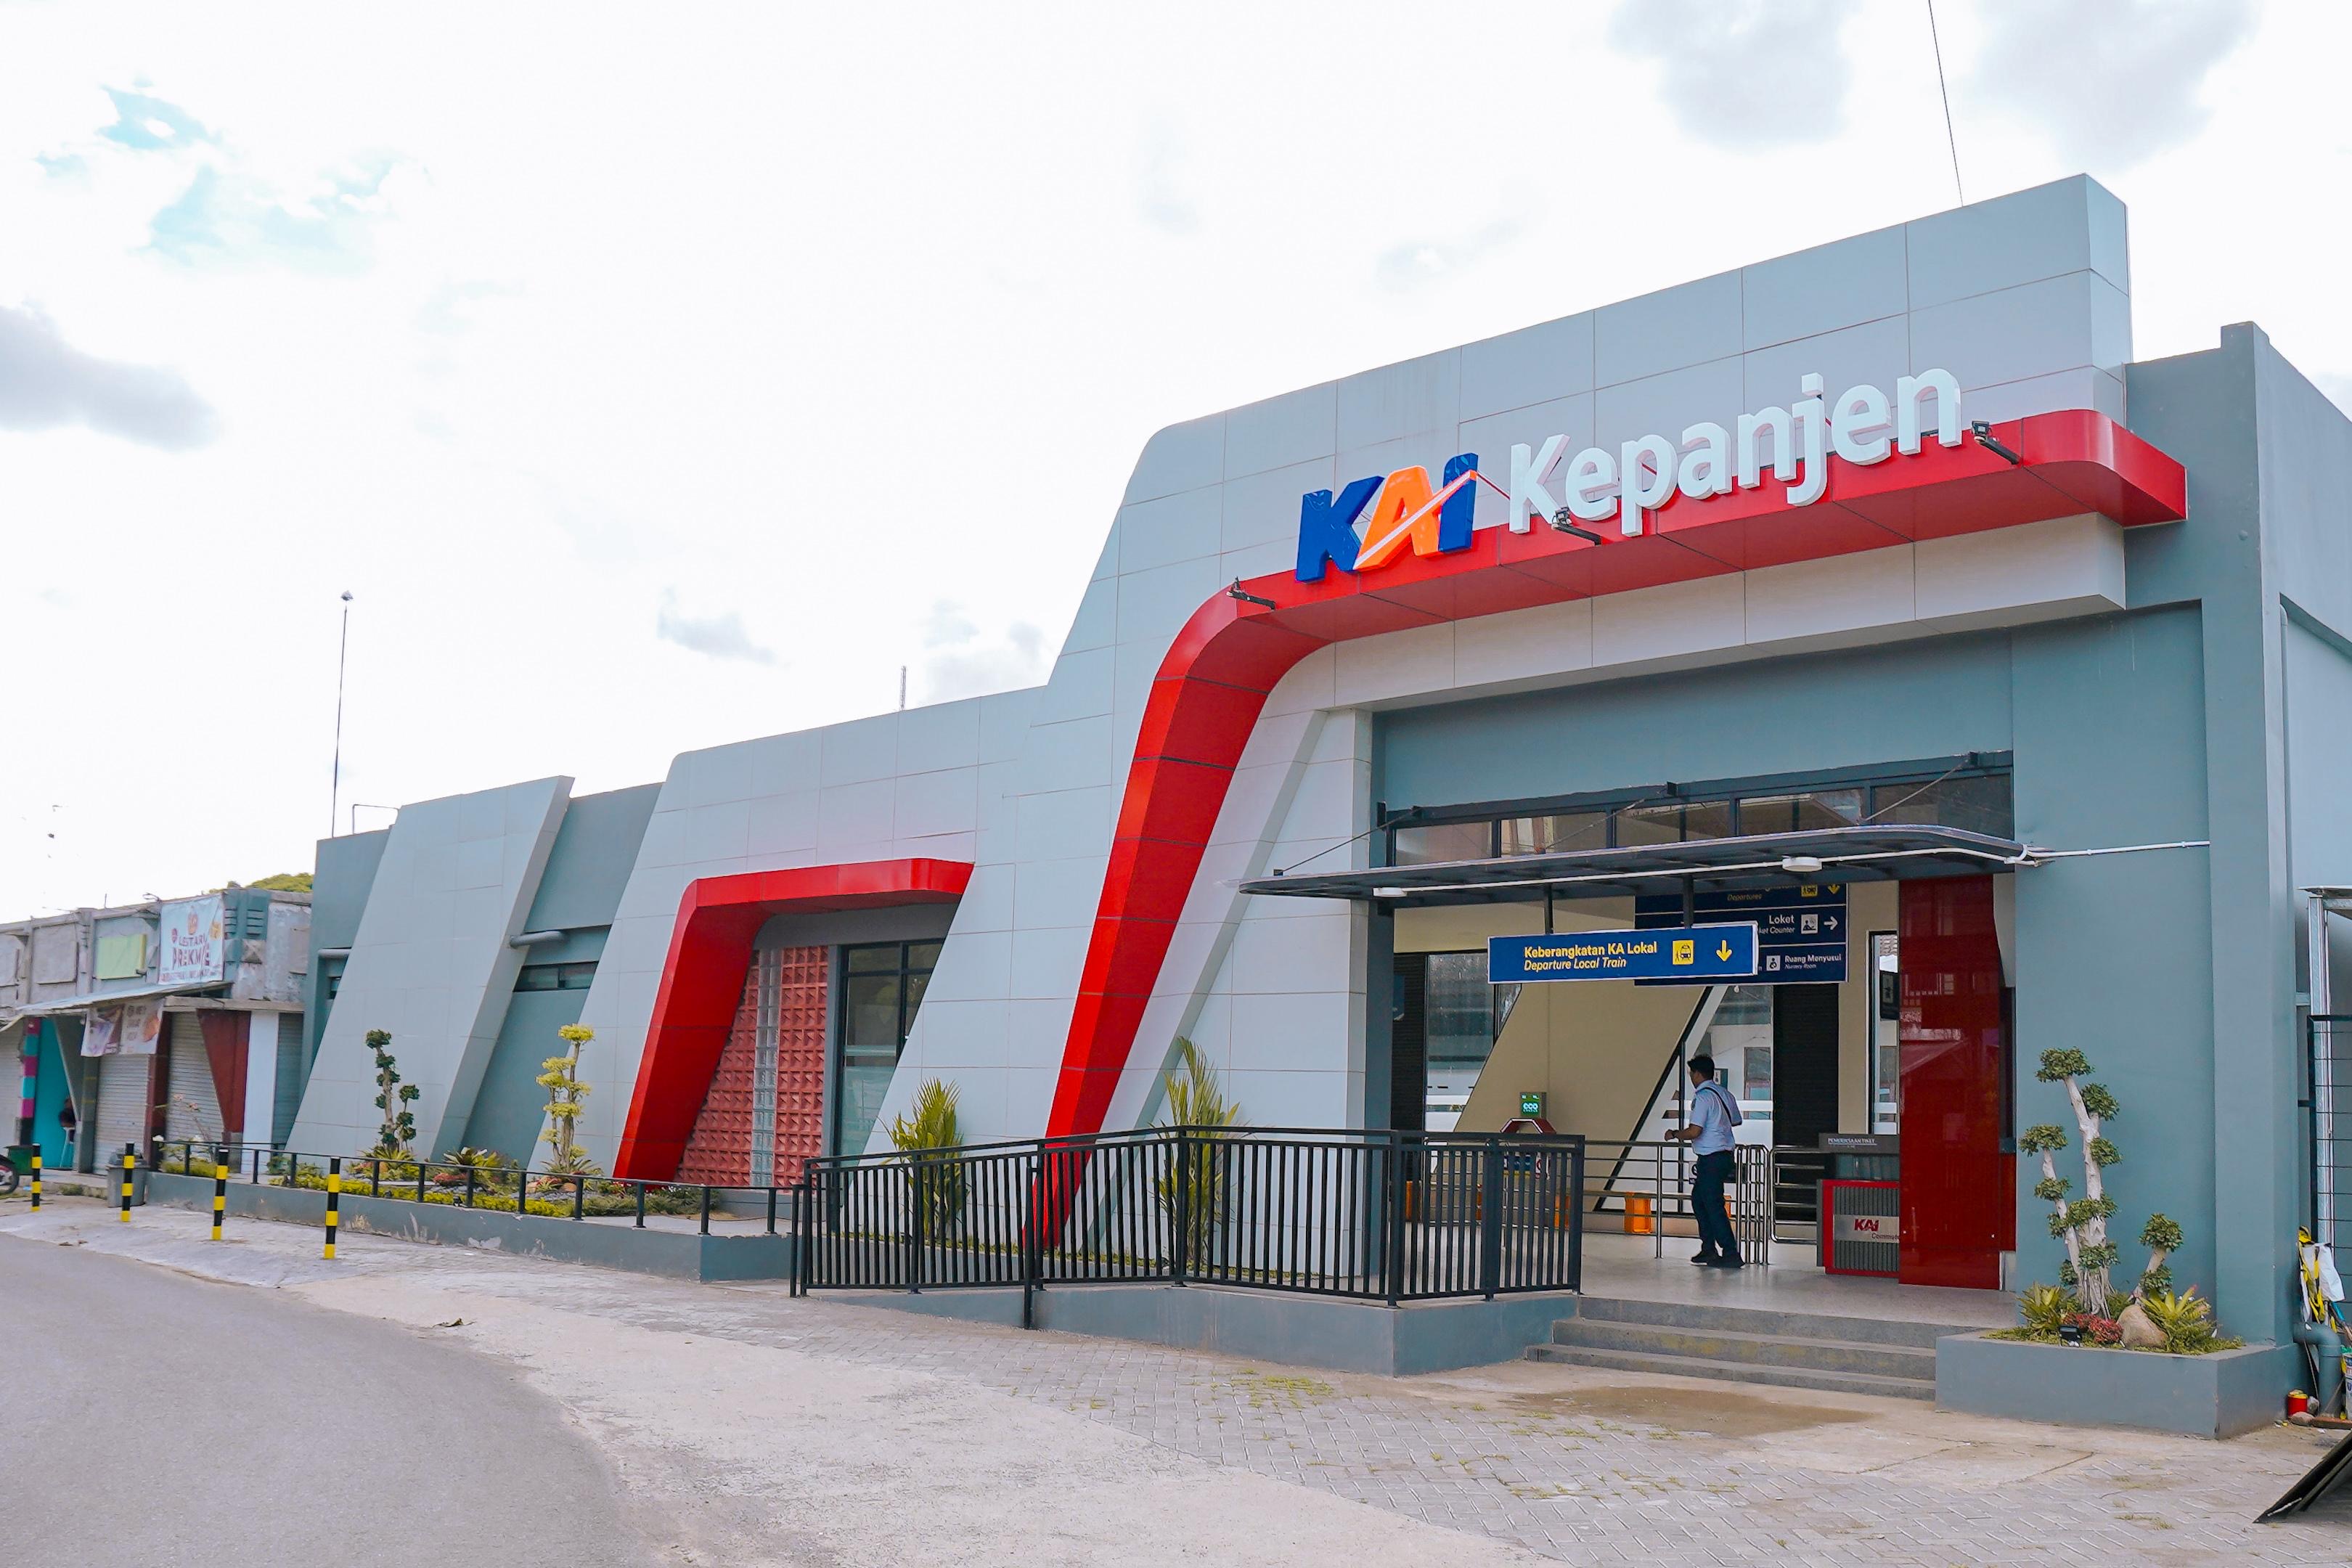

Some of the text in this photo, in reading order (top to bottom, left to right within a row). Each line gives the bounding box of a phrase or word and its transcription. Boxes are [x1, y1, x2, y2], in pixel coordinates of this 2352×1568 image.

[1296, 368, 1963, 584] KAI Kepanjen
[1769, 915, 1794, 924] Loket
[1524, 941, 1657, 959] Keberangkatan KA Lokal
[1524, 956, 1628, 973] Departure Local Train
[1784, 955, 1806, 964] Ruang
[1854, 1218, 1879, 1232] KAI
